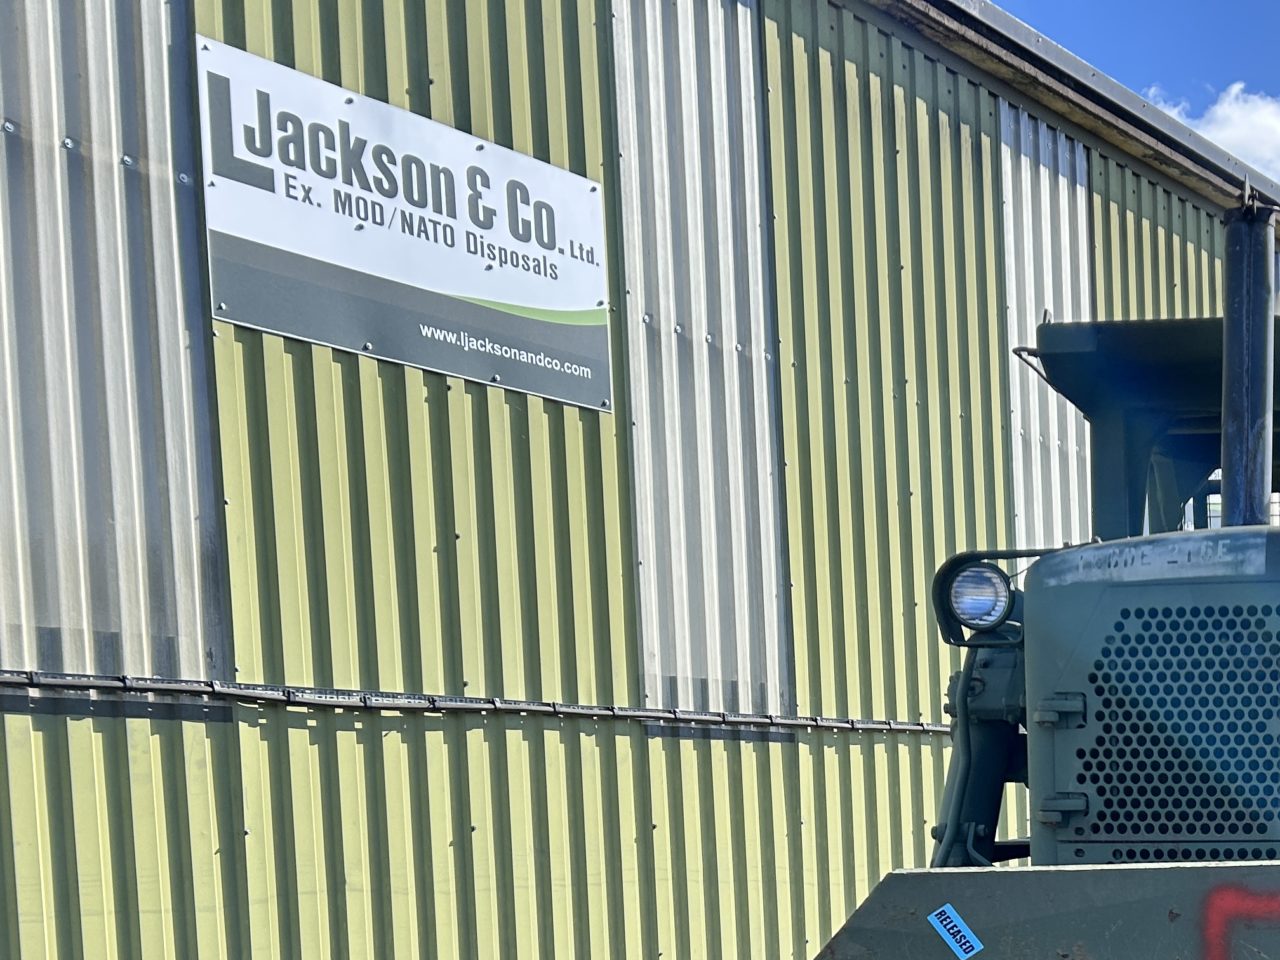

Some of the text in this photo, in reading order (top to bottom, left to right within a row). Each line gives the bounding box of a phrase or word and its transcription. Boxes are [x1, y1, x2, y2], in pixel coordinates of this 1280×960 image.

[284, 172, 558, 281] Ex. MOD/NATO Disposals
[467, 166, 497, 230] &
[506, 179, 565, 255] Co.
[569, 240, 600, 267] Ltd.
[419, 323, 592, 379] www.ljacksonandco.com
[934, 909, 975, 955] RELEASED
